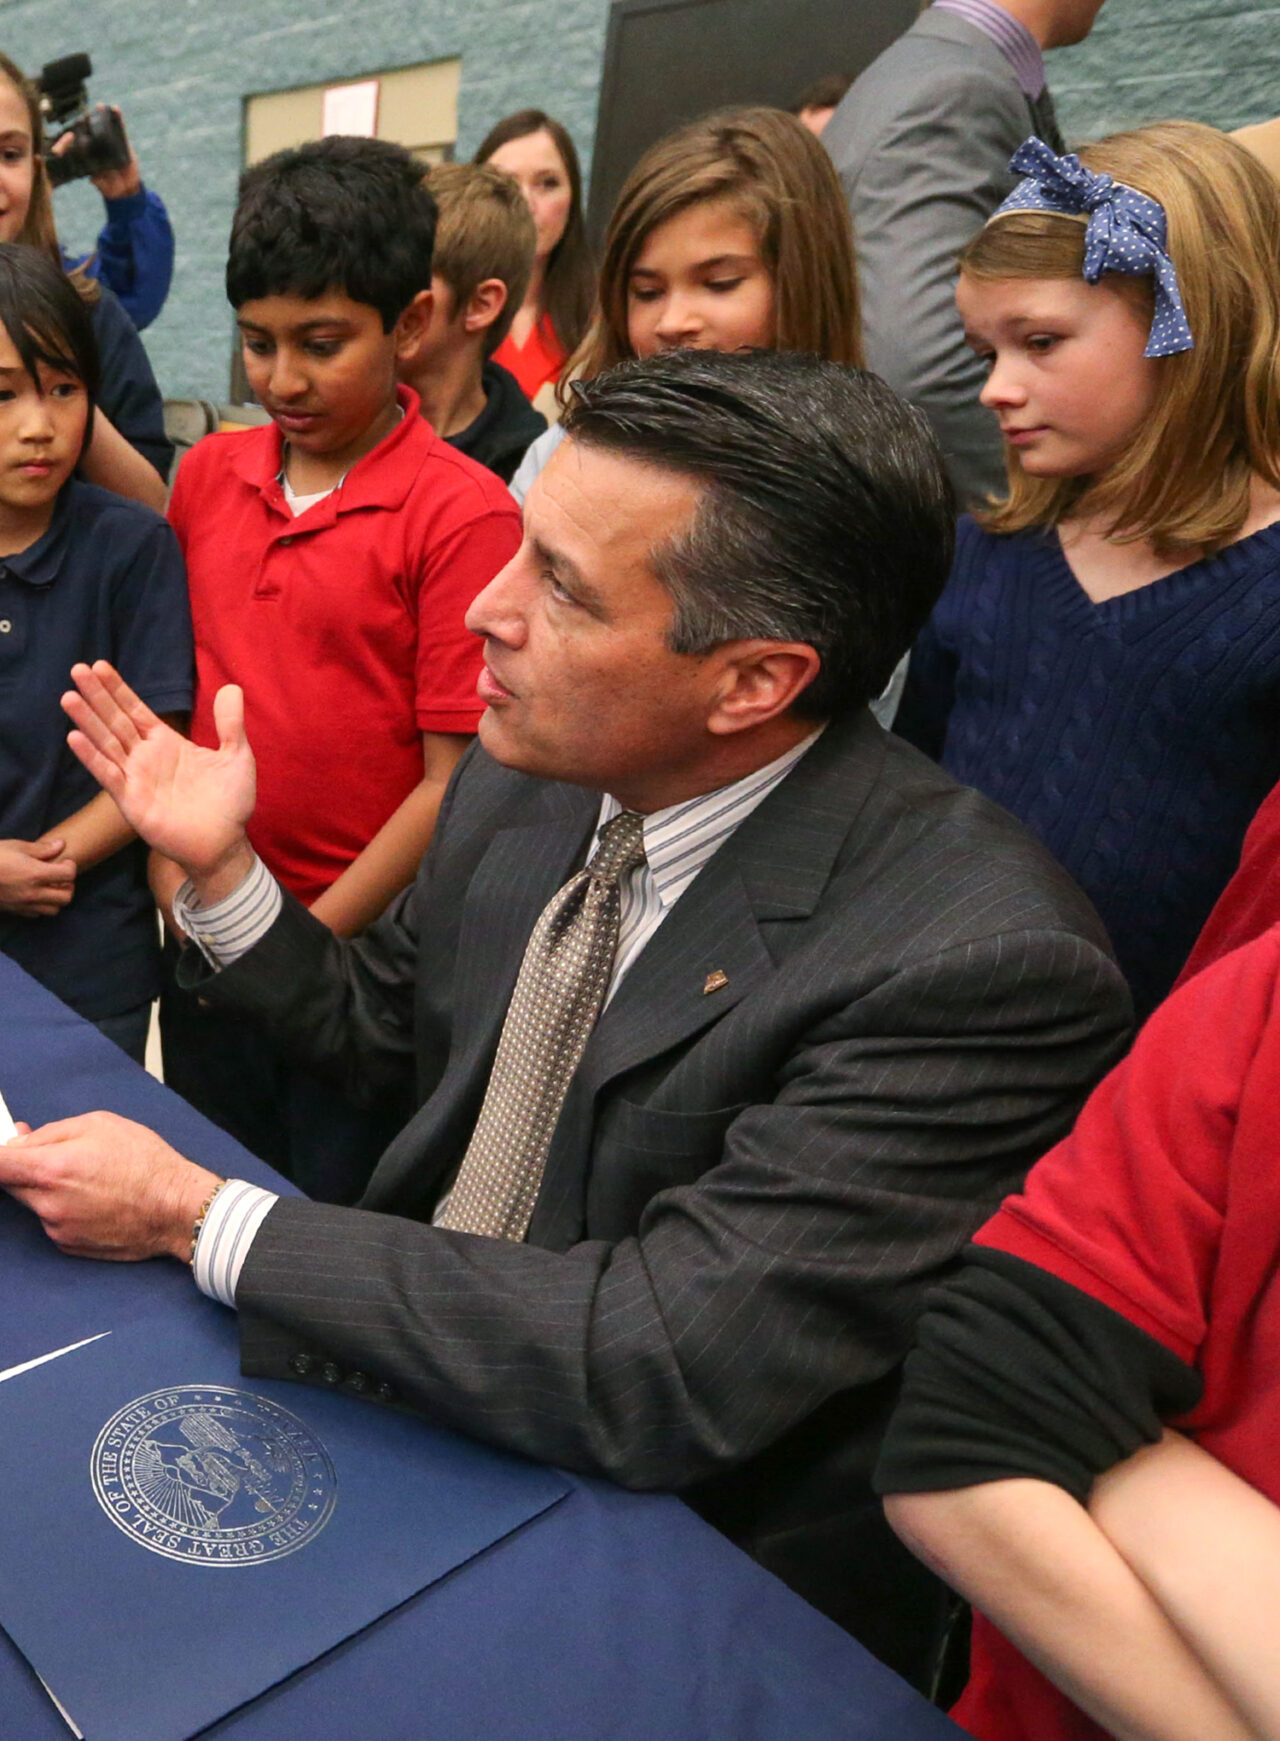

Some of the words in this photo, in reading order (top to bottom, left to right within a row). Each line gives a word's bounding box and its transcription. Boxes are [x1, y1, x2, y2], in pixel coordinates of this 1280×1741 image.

[153, 1394, 180, 1411] OF
[107, 1406, 152, 1448] STATE
[101, 1451, 118, 1486] THE
[107, 1491, 131, 1513] OF
[131, 1514, 181, 1549] SEAL
[269, 1518, 310, 1546] THE
[187, 1539, 265, 1558] GREAT
